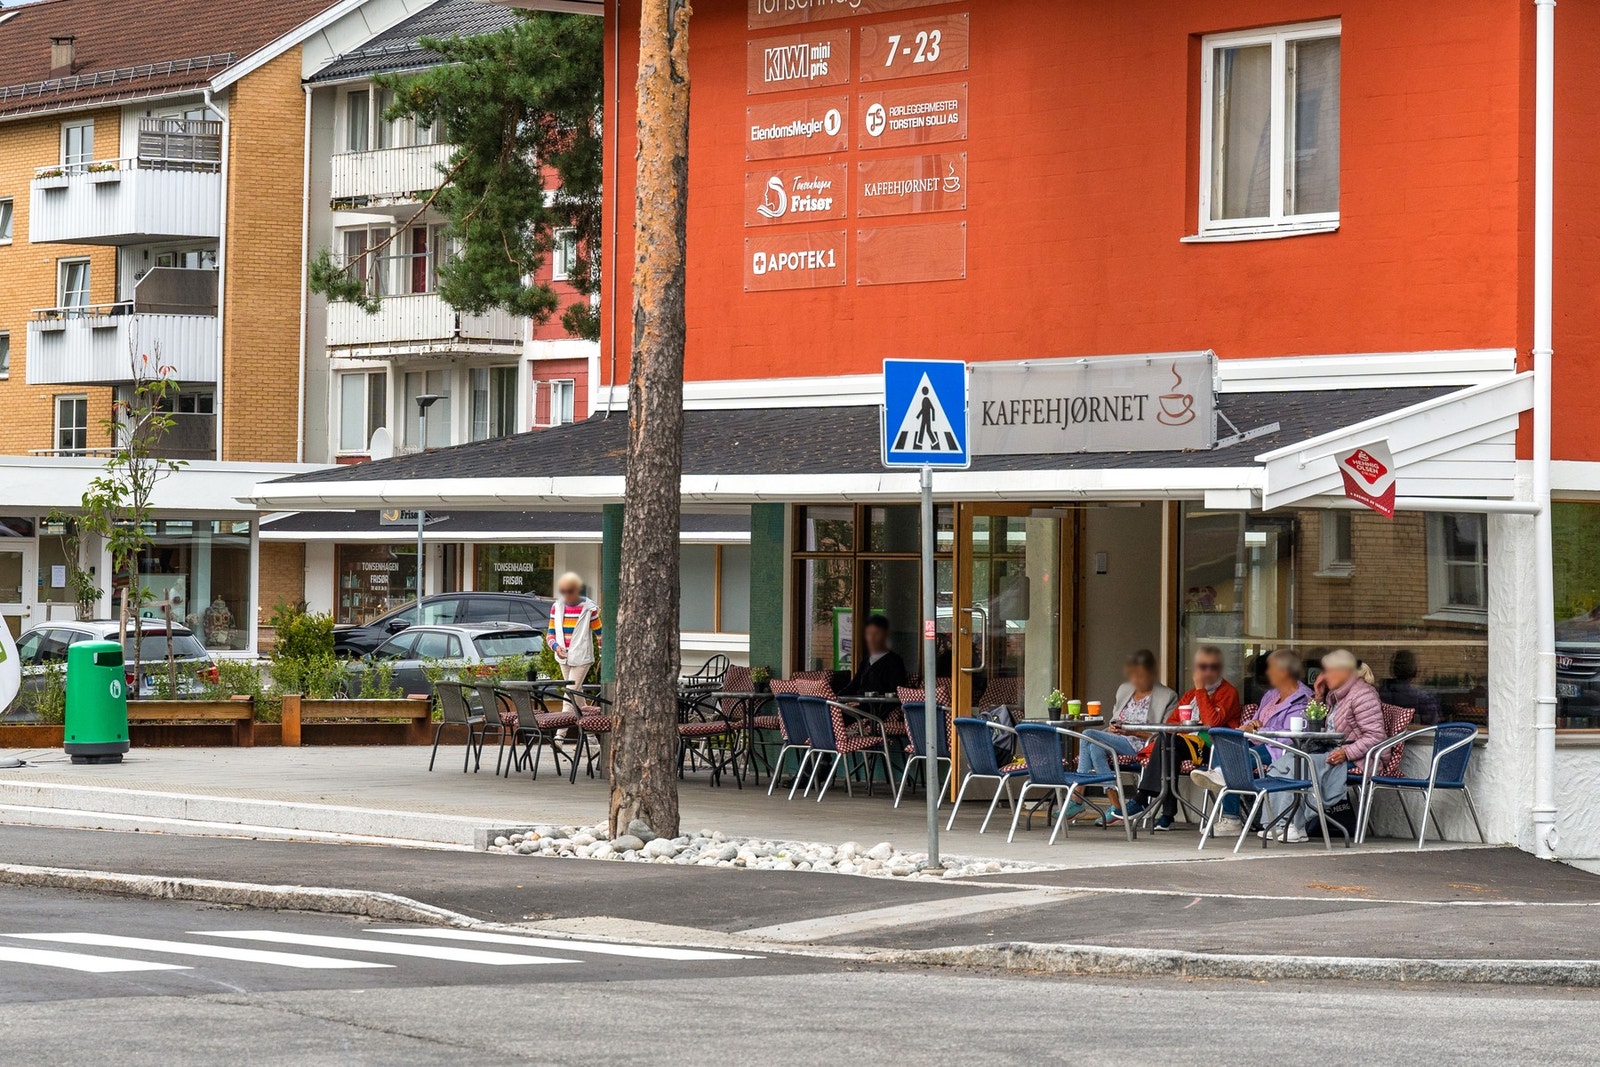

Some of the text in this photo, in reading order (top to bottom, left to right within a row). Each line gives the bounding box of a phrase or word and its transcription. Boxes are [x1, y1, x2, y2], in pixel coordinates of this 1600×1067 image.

[810, 41, 831, 60] mini
[764, 44, 809, 82] KIWI
[810, 59, 829, 80] pris
[889, 100, 958, 117] RØRLEGGERMESTER
[751, 118, 824, 141] EiendomsMegler
[889, 113, 959, 130] TORSTEIN SOLLI AS
[864, 177, 940, 197] KAFFEHJØRNET
[768, 248, 836, 272] APOTEK 1
[982, 394, 1149, 430] KAFFEHJØRNET
[361, 562, 400, 572] TONSENHAGEN
[493, 562, 534, 572] TONSENHAGEN
[370, 574, 389, 584] FRISØR
[502, 575, 523, 586] FRISØR
